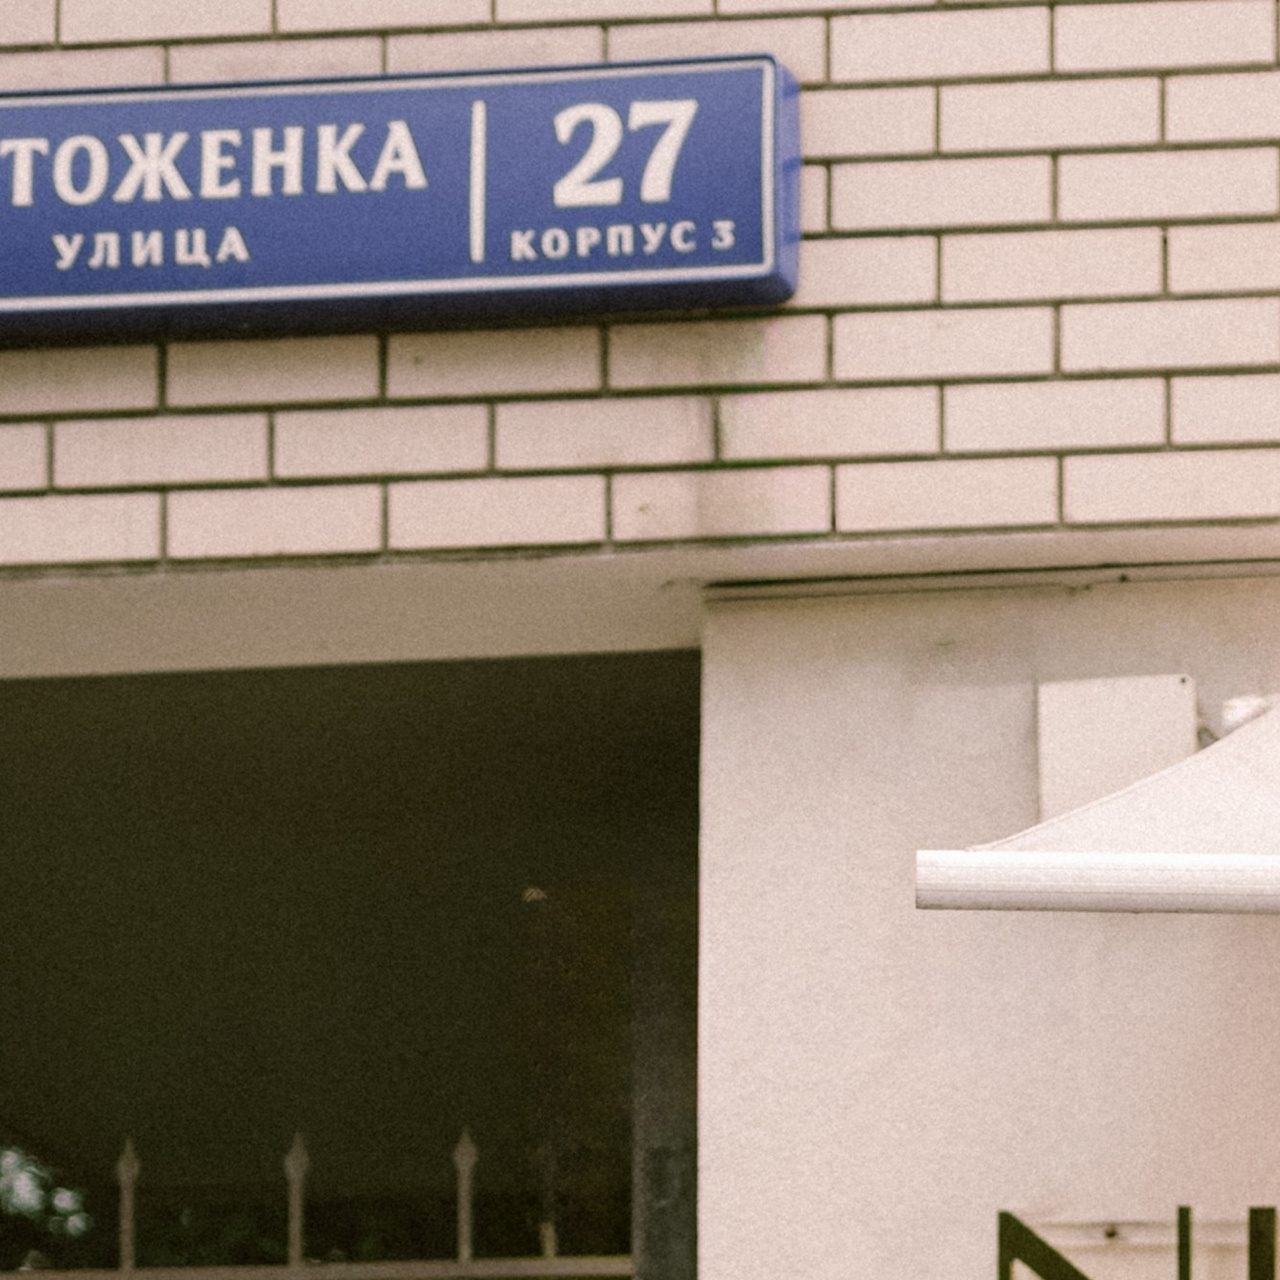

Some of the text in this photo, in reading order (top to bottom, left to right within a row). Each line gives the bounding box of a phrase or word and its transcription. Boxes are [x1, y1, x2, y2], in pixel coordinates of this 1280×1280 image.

[0, 119, 429, 206] ТОЖЕНКА
[553, 98, 699, 208] 27
[51, 226, 251, 270] УЛИЦА
[510, 219, 736, 261] КОРПУС 3
